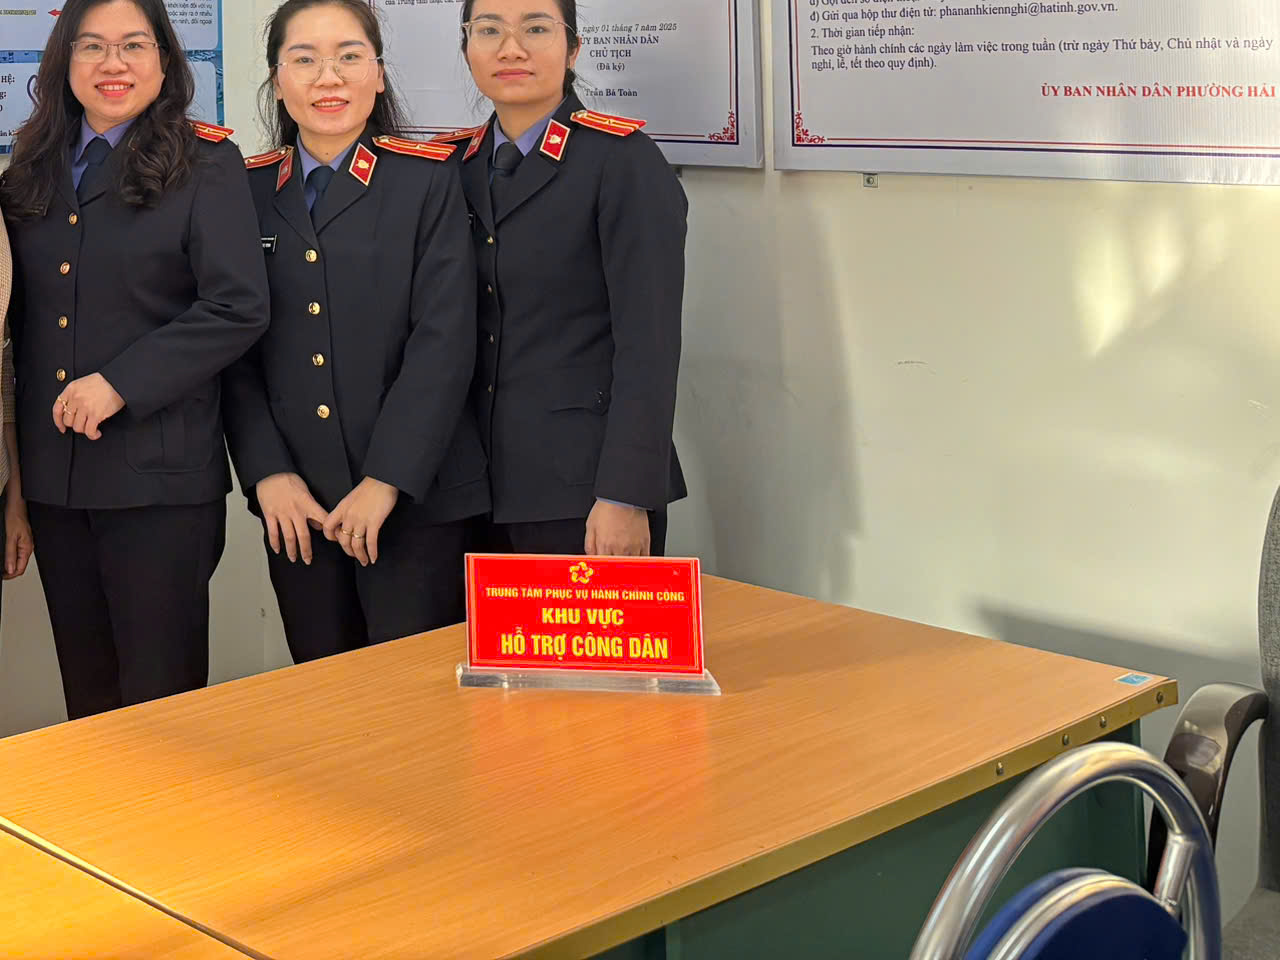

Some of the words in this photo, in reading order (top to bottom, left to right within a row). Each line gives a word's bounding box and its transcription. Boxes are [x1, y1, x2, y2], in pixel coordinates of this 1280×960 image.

[809, 10, 820, 23] đ)
[821, 9, 839, 21] Gửi
[841, 11, 859, 23] qua
[860, 8, 879, 21] hộp
[881, 7, 898, 19] thư
[899, 7, 921, 18] điện
[923, 5, 937, 17] tử:
[939, 0, 1119, 20] phananhkiennghi@hatinh.gov.vn.
[810, 28, 819, 38] 2.
[821, 26, 843, 38] Thời
[845, 26, 866, 39] gian
[867, 23, 886, 39] tiếp
[888, 24, 915, 37] nhận:
[593, 36, 611, 44] BAN
[613, 34, 638, 44] NHÂN
[640, 34, 659, 44] DÂN
[589, 46, 608, 58] CHỦ
[609, 48, 632, 59] TỊCH
[596, 62, 611, 70] (Đã
[611, 61, 626, 72] ký)
[1, 73, 16, 85] HỆ:
[605, 88, 617, 96] Bá
[617, 88, 638, 96] Toàn
[1041, 82, 1060, 97] ỦY
[1063, 85, 1092, 97] BAN
[1095, 81, 1137, 97] NHÂN
[1142, 81, 1172, 97] DÂN
[1177, 82, 1244, 97] PHƯỜNG
[1247, 82, 1276, 97] HẢI
[486, 587, 519, 597] TRUNG
[521, 587, 543, 598] TÂM
[545, 588, 573, 600] PHỤC
[575, 589, 589, 600] VỤ
[591, 588, 620, 600] HÀNH
[621, 590, 654, 601] CHÍNH
[656, 590, 685, 601] CÔNG
[542, 607, 581, 624] KHU
[586, 607, 625, 629] VỰC
[501, 628, 526, 655] HỖ
[530, 632, 567, 661] TRỢ
[571, 631, 623, 657] CÔNG
[628, 632, 669, 659] DÂN
